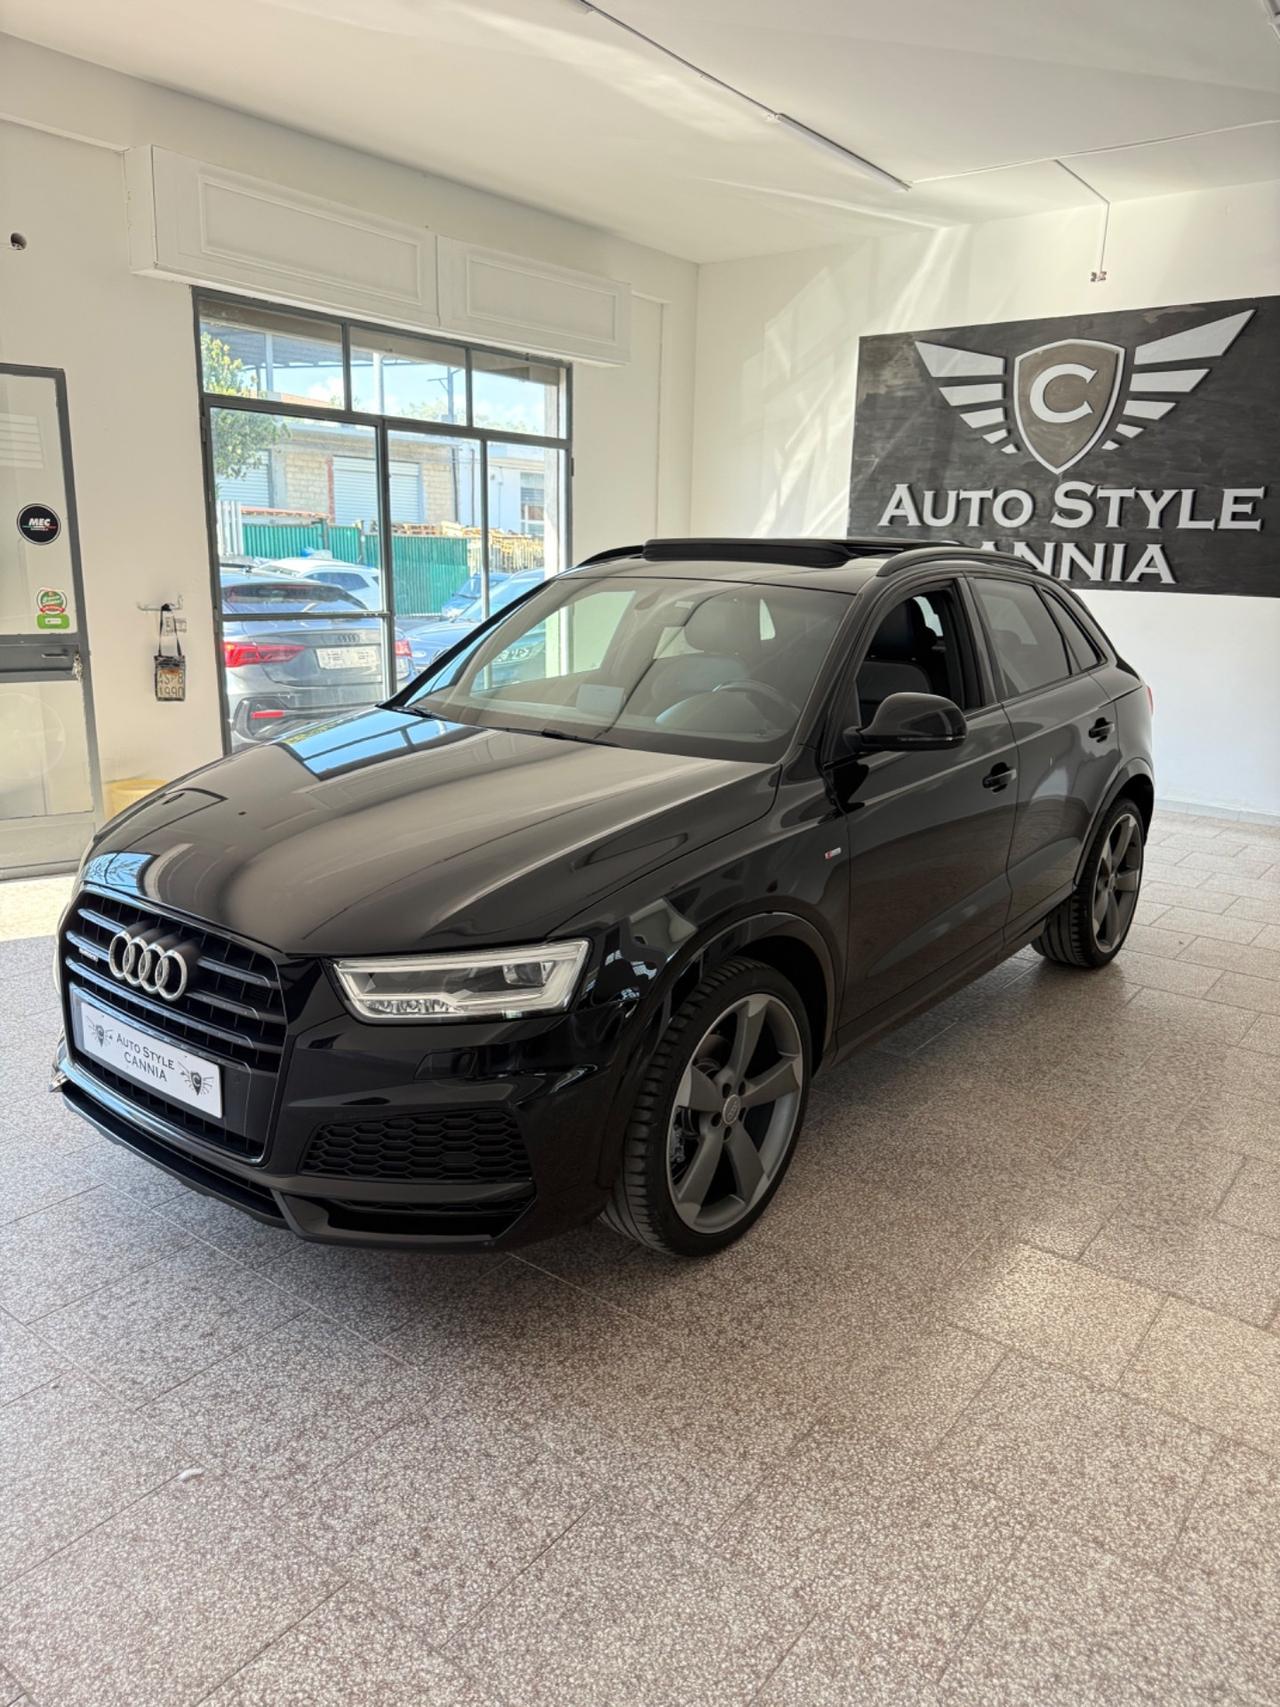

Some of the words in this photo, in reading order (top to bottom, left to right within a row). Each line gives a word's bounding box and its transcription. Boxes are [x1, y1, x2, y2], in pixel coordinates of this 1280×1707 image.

[1029, 363, 1098, 423] C
[877, 483, 1034, 528] AUTO
[1050, 480, 1265, 532] STYLE
[980, 540, 1176, 584] NNIA
[116, 1033, 141, 1054] AUTO
[142, 1046, 175, 1071] STYLE
[123, 1051, 168, 1082] CANNIA
